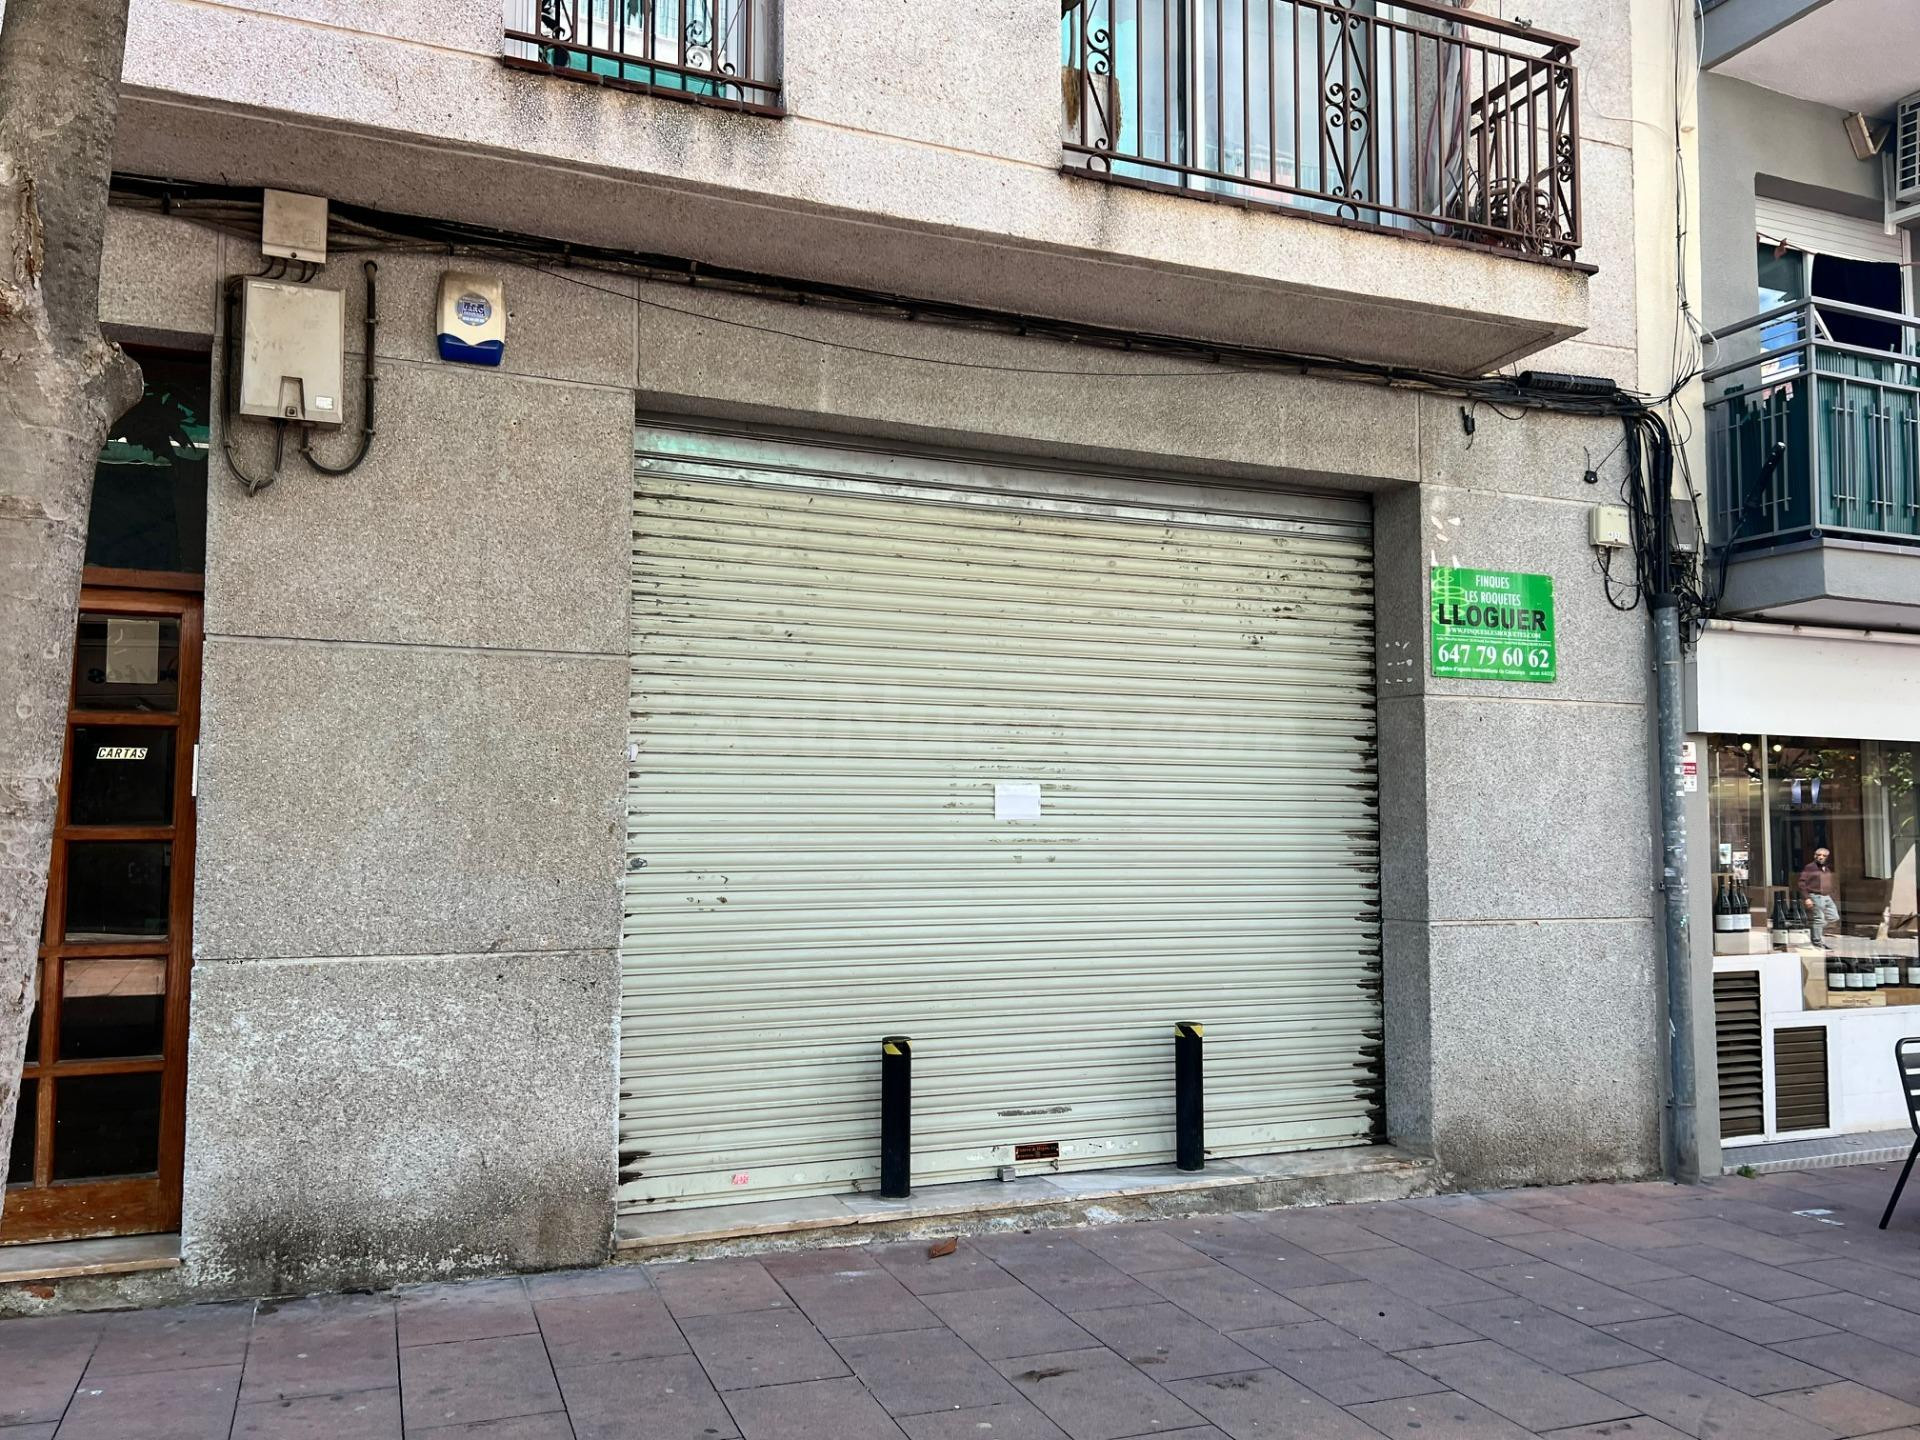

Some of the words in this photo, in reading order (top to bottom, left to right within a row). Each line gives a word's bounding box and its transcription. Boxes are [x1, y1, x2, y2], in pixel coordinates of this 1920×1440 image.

[1475, 574, 1510, 590] FINQUES
[1465, 590, 1479, 603] LES
[1481, 591, 1521, 606] ROQUETES
[1439, 603, 1547, 631] LLOGUER
[1438, 643, 1471, 664] 647
[1476, 645, 1497, 665] 79
[1502, 647, 1523, 667] 60
[1528, 649, 1550, 668] 62
[98, 748, 146, 759] CARTAS
